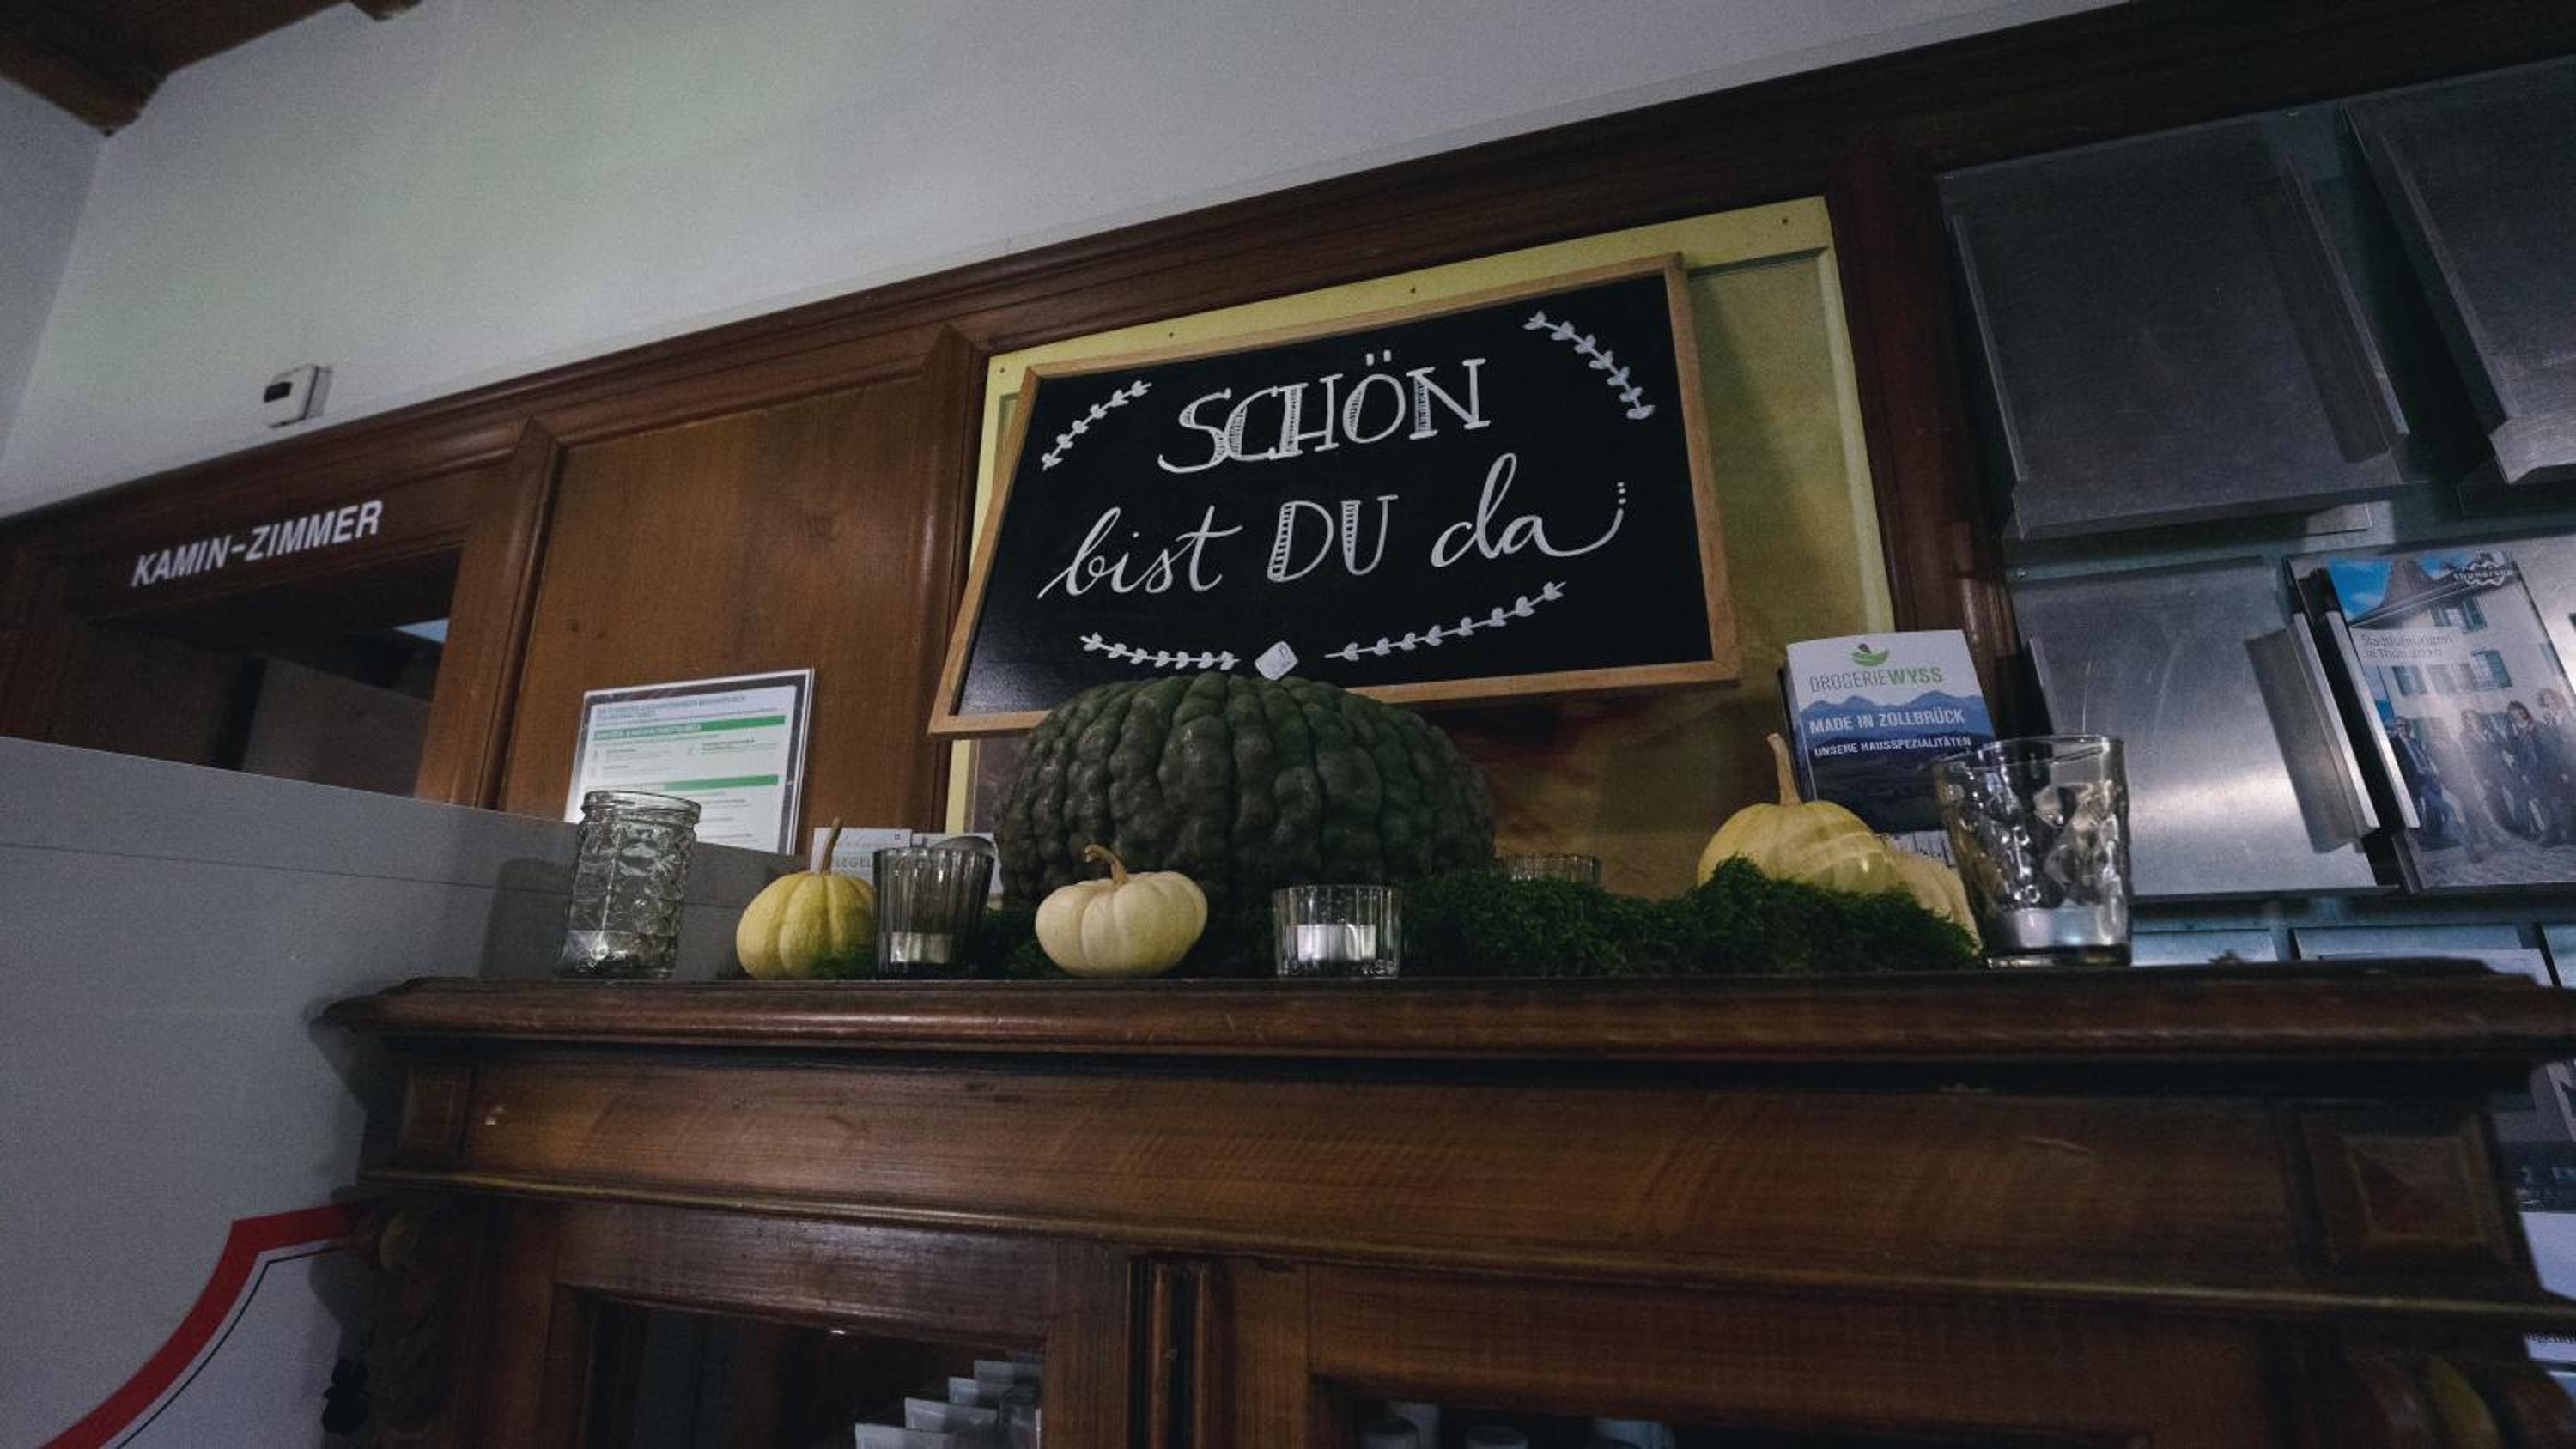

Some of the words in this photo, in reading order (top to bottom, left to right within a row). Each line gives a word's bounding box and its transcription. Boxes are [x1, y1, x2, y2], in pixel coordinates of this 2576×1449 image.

[1157, 348, 1492, 475] SCHÖN
[130, 499, 385, 589] KAMIN-ZIMMER
[1036, 505, 1244, 601] bist
[1266, 493, 1400, 584] DU
[1809, 667, 1942, 693] DROGERIEWYSS
[1809, 715, 1854, 735] MADE
[1856, 713, 1874, 729] IN
[1879, 706, 1965, 728] ZOLLBRÜCK
[1814, 742, 1859, 759] UNSERE
[1860, 734, 1971, 752] HAUSSPEZIALITÄTEN
